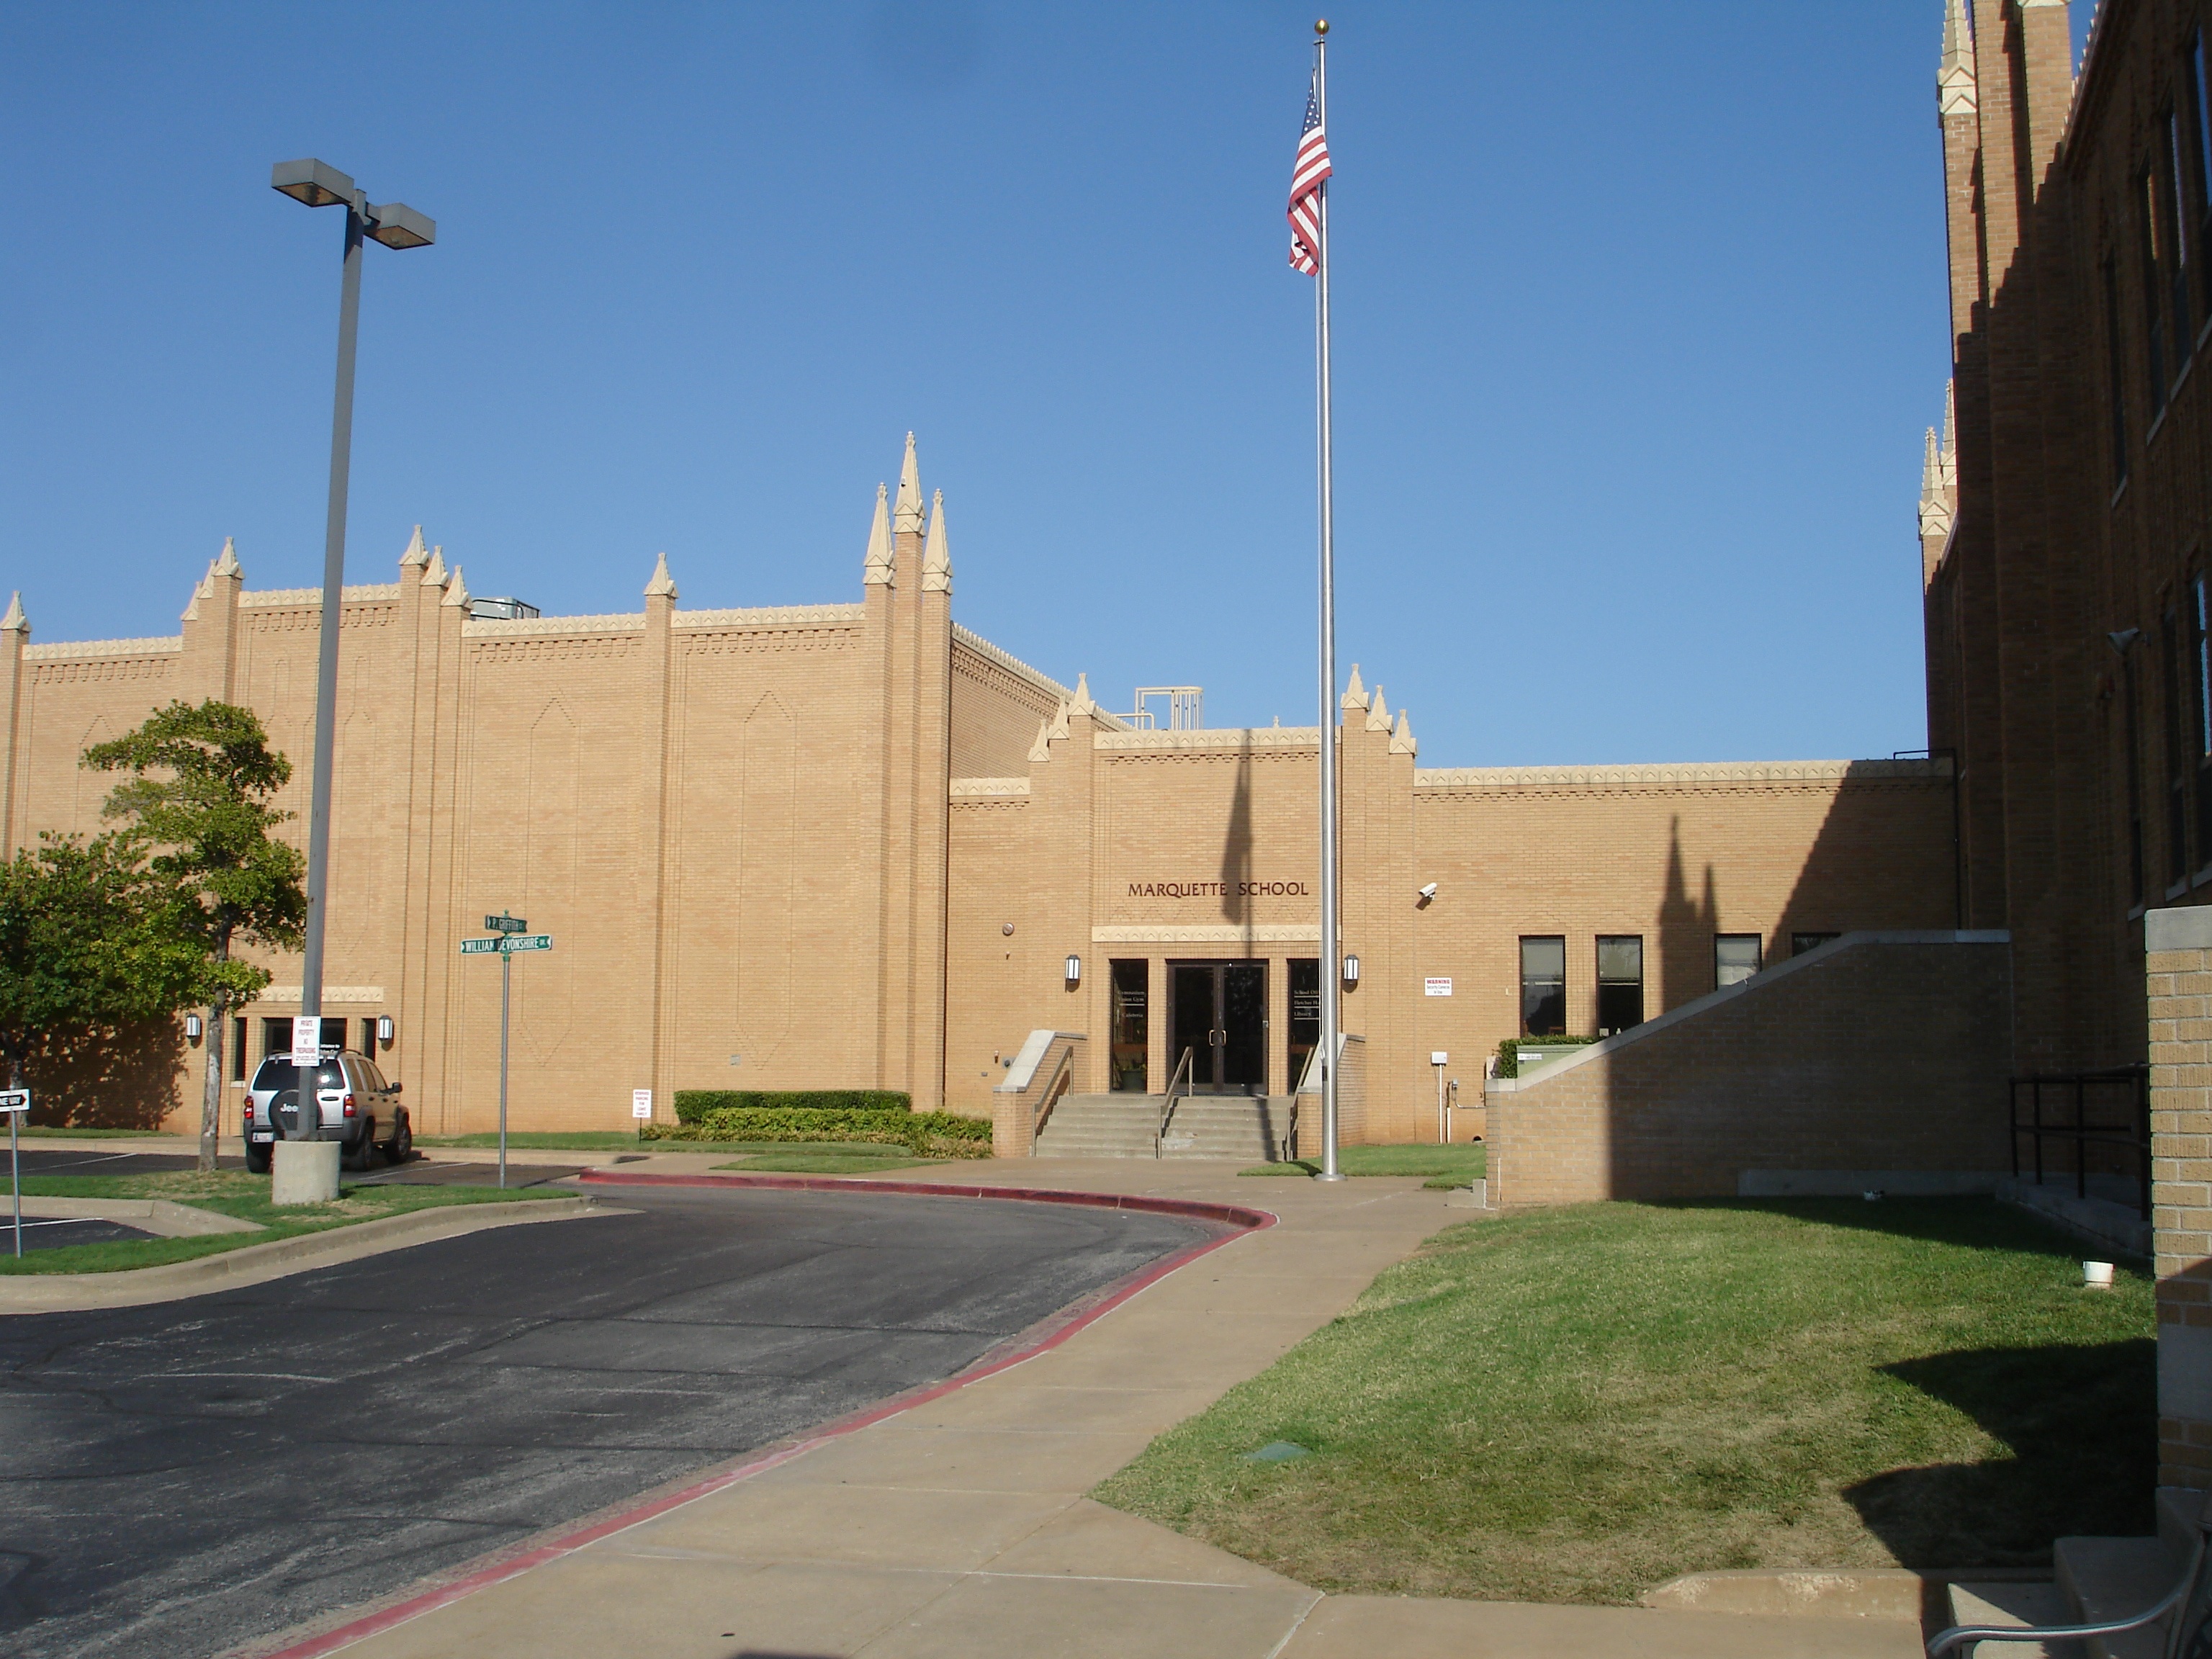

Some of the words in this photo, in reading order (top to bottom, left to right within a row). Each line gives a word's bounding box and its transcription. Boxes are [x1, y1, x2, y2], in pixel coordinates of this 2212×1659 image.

[1128, 883, 1228, 898] MARQUETTE
[1238, 881, 1309, 896] SCHOOL
[465, 940, 495, 952] WILLIAM
[498, 938, 539, 951] DEVONSHIRE
[280, 1103, 300, 1112] Jee
